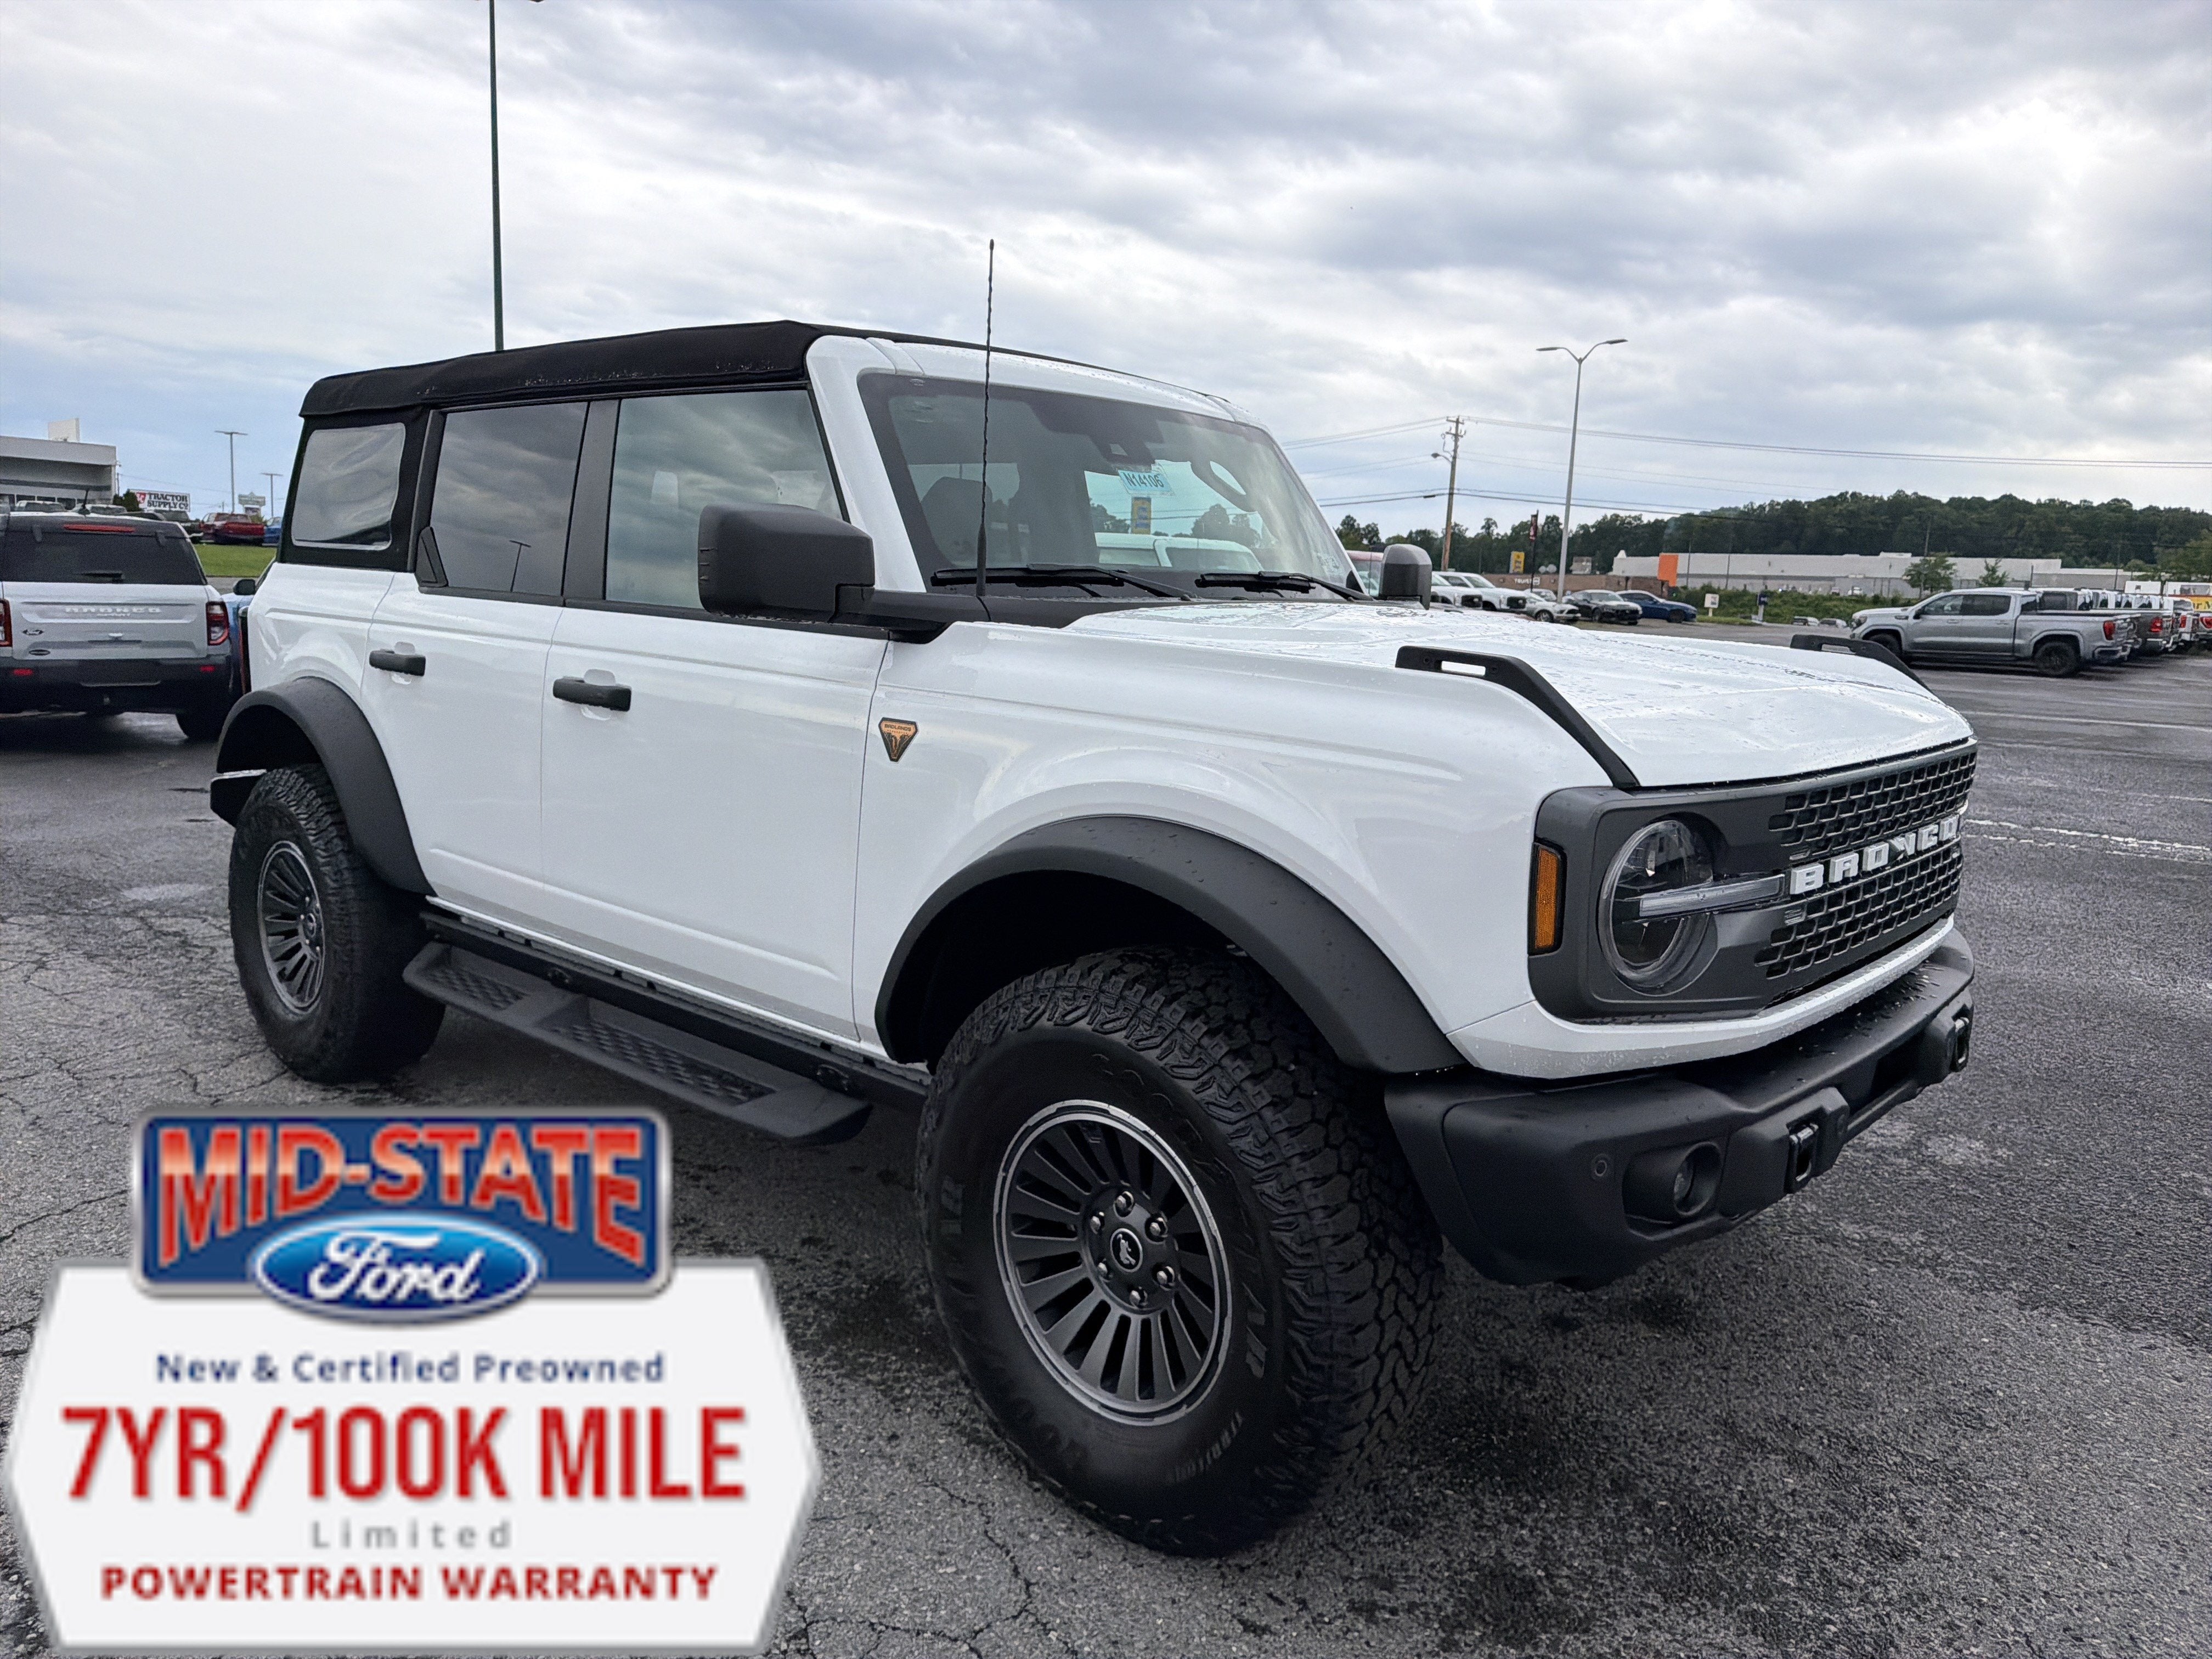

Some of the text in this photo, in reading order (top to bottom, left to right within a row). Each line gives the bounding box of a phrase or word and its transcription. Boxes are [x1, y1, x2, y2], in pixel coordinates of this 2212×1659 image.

[1122, 472, 1164, 488] N14106
[147, 493, 188, 501] TRACTOR
[147, 500, 178, 509] SUPPLY
[884, 724, 911, 732] BADLANDS
[1789, 814, 1960, 895] BRONCO
